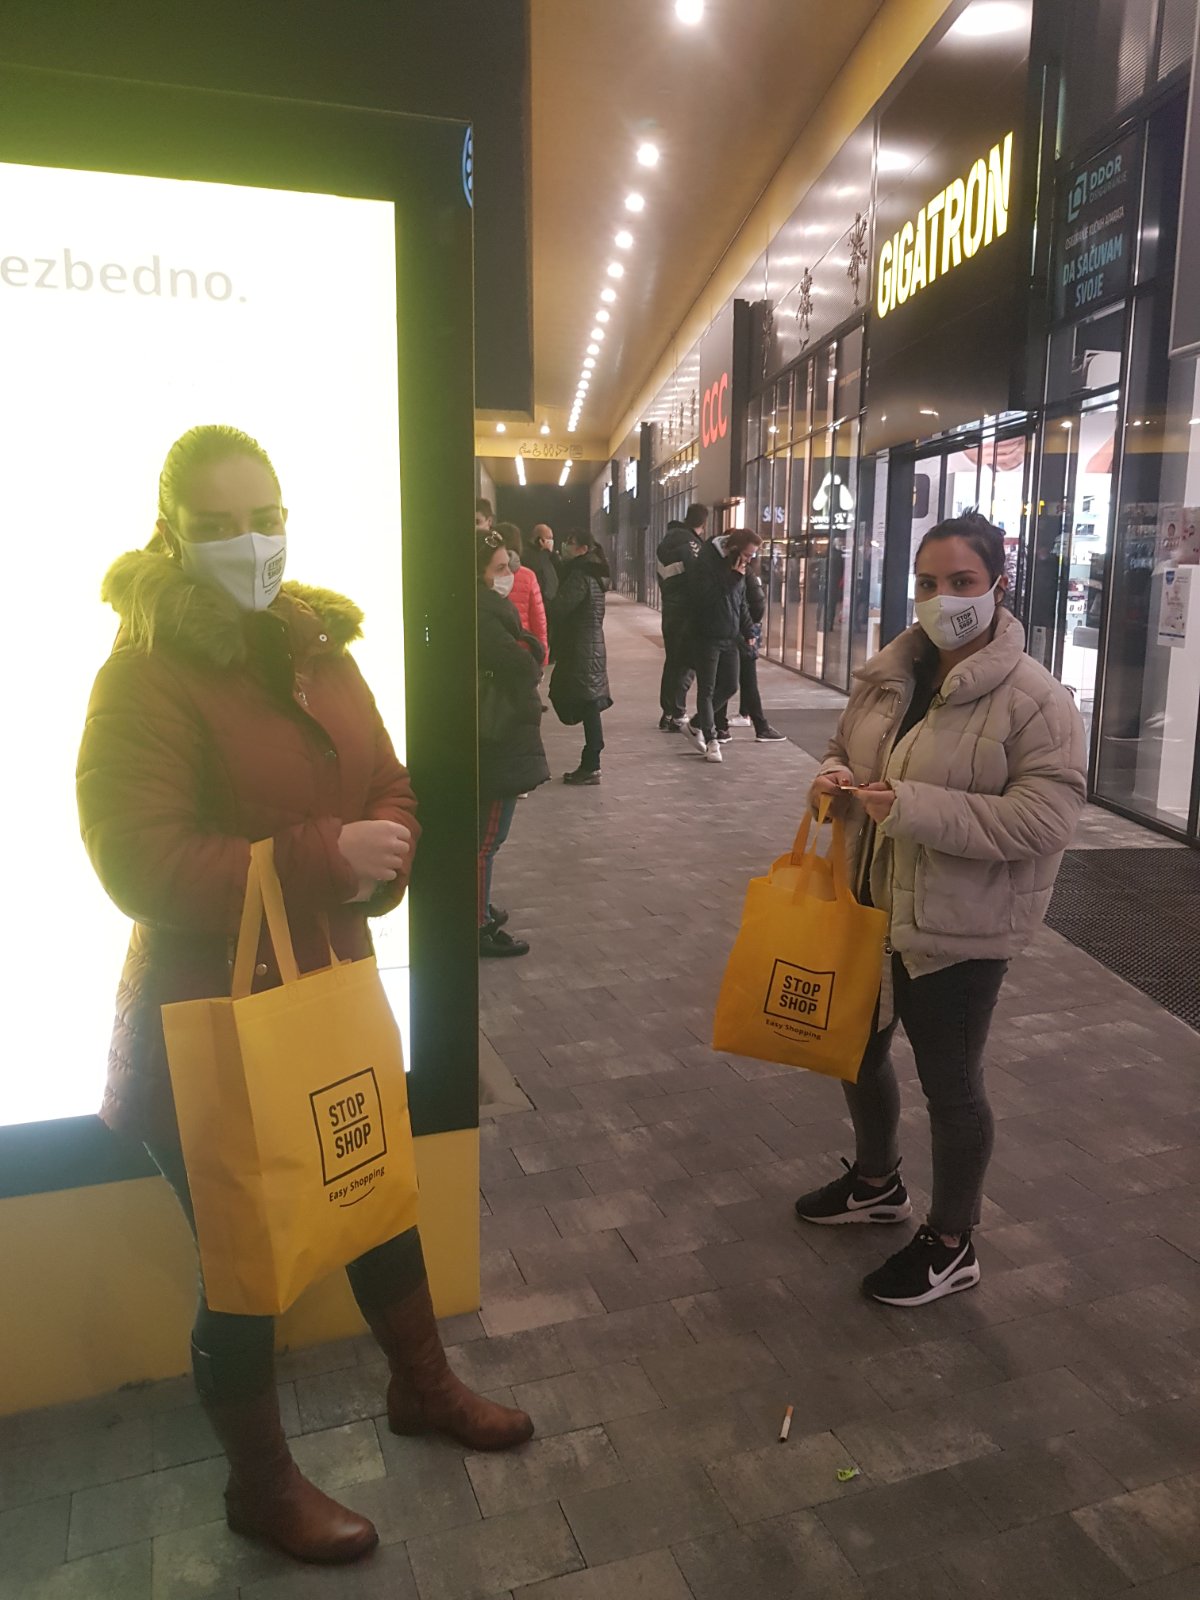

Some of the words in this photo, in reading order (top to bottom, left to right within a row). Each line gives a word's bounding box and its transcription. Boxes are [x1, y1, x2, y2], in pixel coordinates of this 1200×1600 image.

[1090, 154, 1122, 190] DDOR
[877, 131, 1013, 319] GIGATRON
[1063, 260, 1075, 287] DA
[1077, 233, 1123, 278] SAČUVAM
[1075, 273, 1104, 308] SVOJE
[702, 372, 728, 449] CCC
[956, 612, 971, 623] STOP
[958, 618, 973, 630] SHOP
[783, 975, 821, 997] STOP
[779, 994, 817, 1015] SHOP
[766, 1018, 784, 1030] Easy
[784, 1023, 822, 1041] Shopping
[329, 1092, 366, 1127] STOP
[335, 1122, 372, 1159] SHOP
[329, 1185, 349, 1202] Easy
[350, 1165, 386, 1192] Shopping
